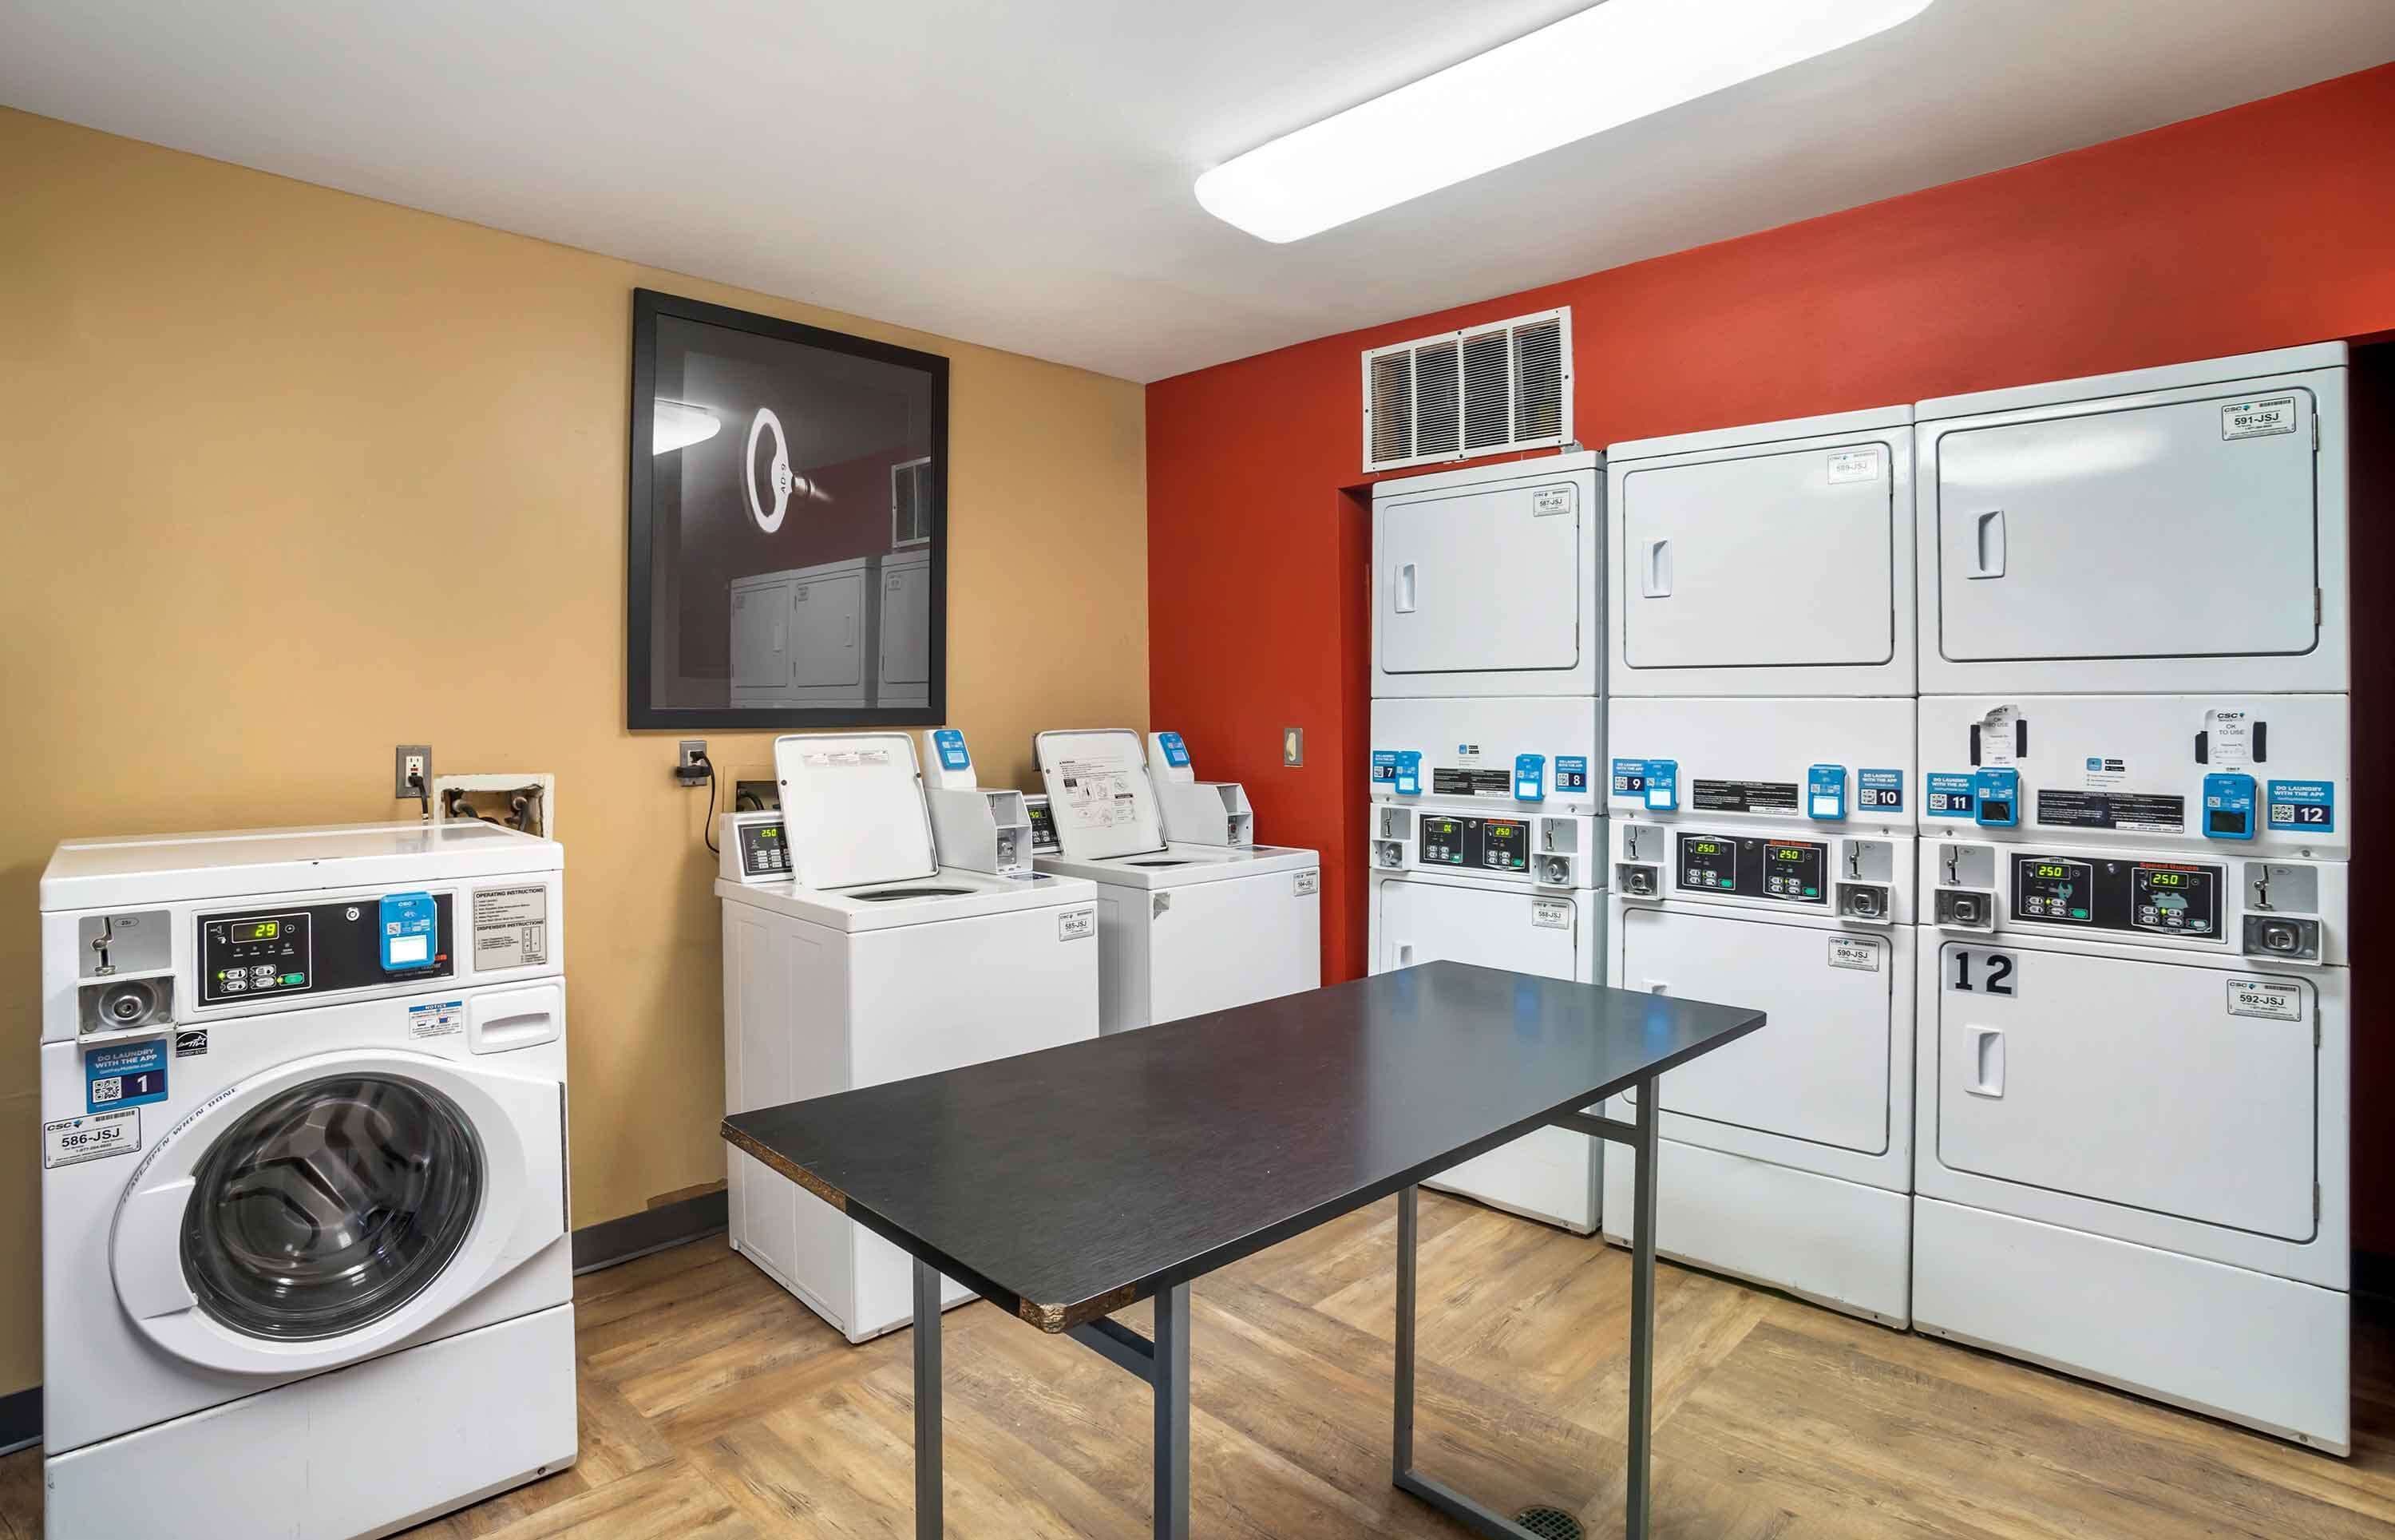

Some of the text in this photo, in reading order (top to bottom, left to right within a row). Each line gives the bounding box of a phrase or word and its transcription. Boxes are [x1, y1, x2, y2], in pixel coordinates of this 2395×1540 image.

[2235, 413, 2279, 426] 591-JSJ
[1388, 768, 1393, 777] 7
[1574, 775, 1580, 786] 8
[1633, 778, 1641, 790] 9
[1879, 792, 1897, 804] 10
[1953, 797, 1965, 809] 11
[2301, 807, 2323, 822] 12
[1697, 844, 1715, 853] 250
[1779, 849, 1799, 860] 250
[2039, 866, 2062, 877] 250
[2153, 874, 2178, 885] 250
[255, 924, 275, 937] 29
[1837, 949, 1868, 959] 590-JSJ
[2239, 994, 2285, 1006] 592-JSJ
[95, 1053, 158, 1068] WITH THE APP
[97, 1048, 155, 1062] DO LAUNDRY
[137, 1075, 148, 1093] 1
[47, 1121, 72, 1132] CSC
[172, 1107, 205, 1136] WHEN
[61, 1127, 121, 1148] 586-JSJ
